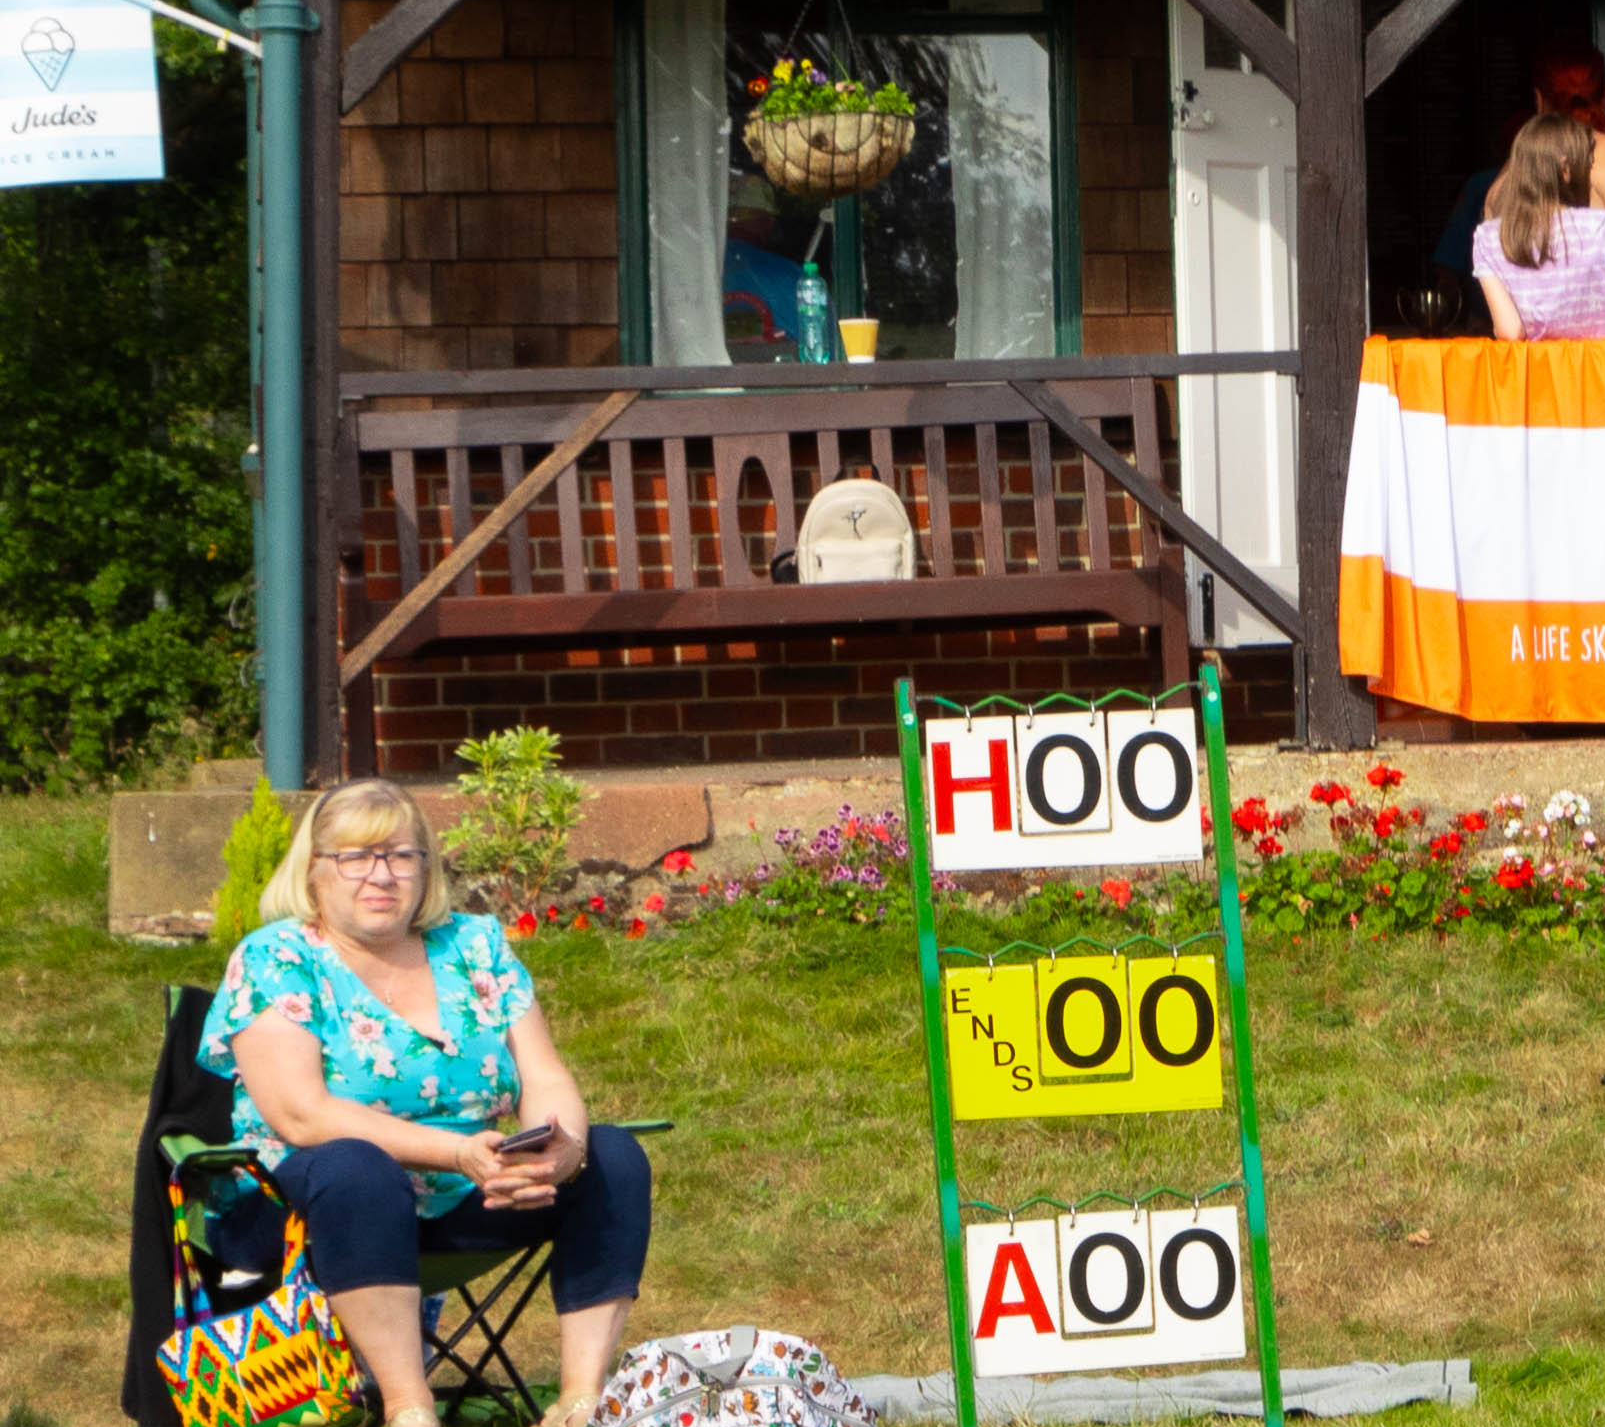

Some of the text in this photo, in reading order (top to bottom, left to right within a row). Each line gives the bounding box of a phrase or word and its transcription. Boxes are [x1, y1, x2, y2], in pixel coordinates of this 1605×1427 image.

[11, 103, 97, 135] Jude's
[1511, 624, 1525, 661] A
[1533, 624, 1570, 661] LIFE
